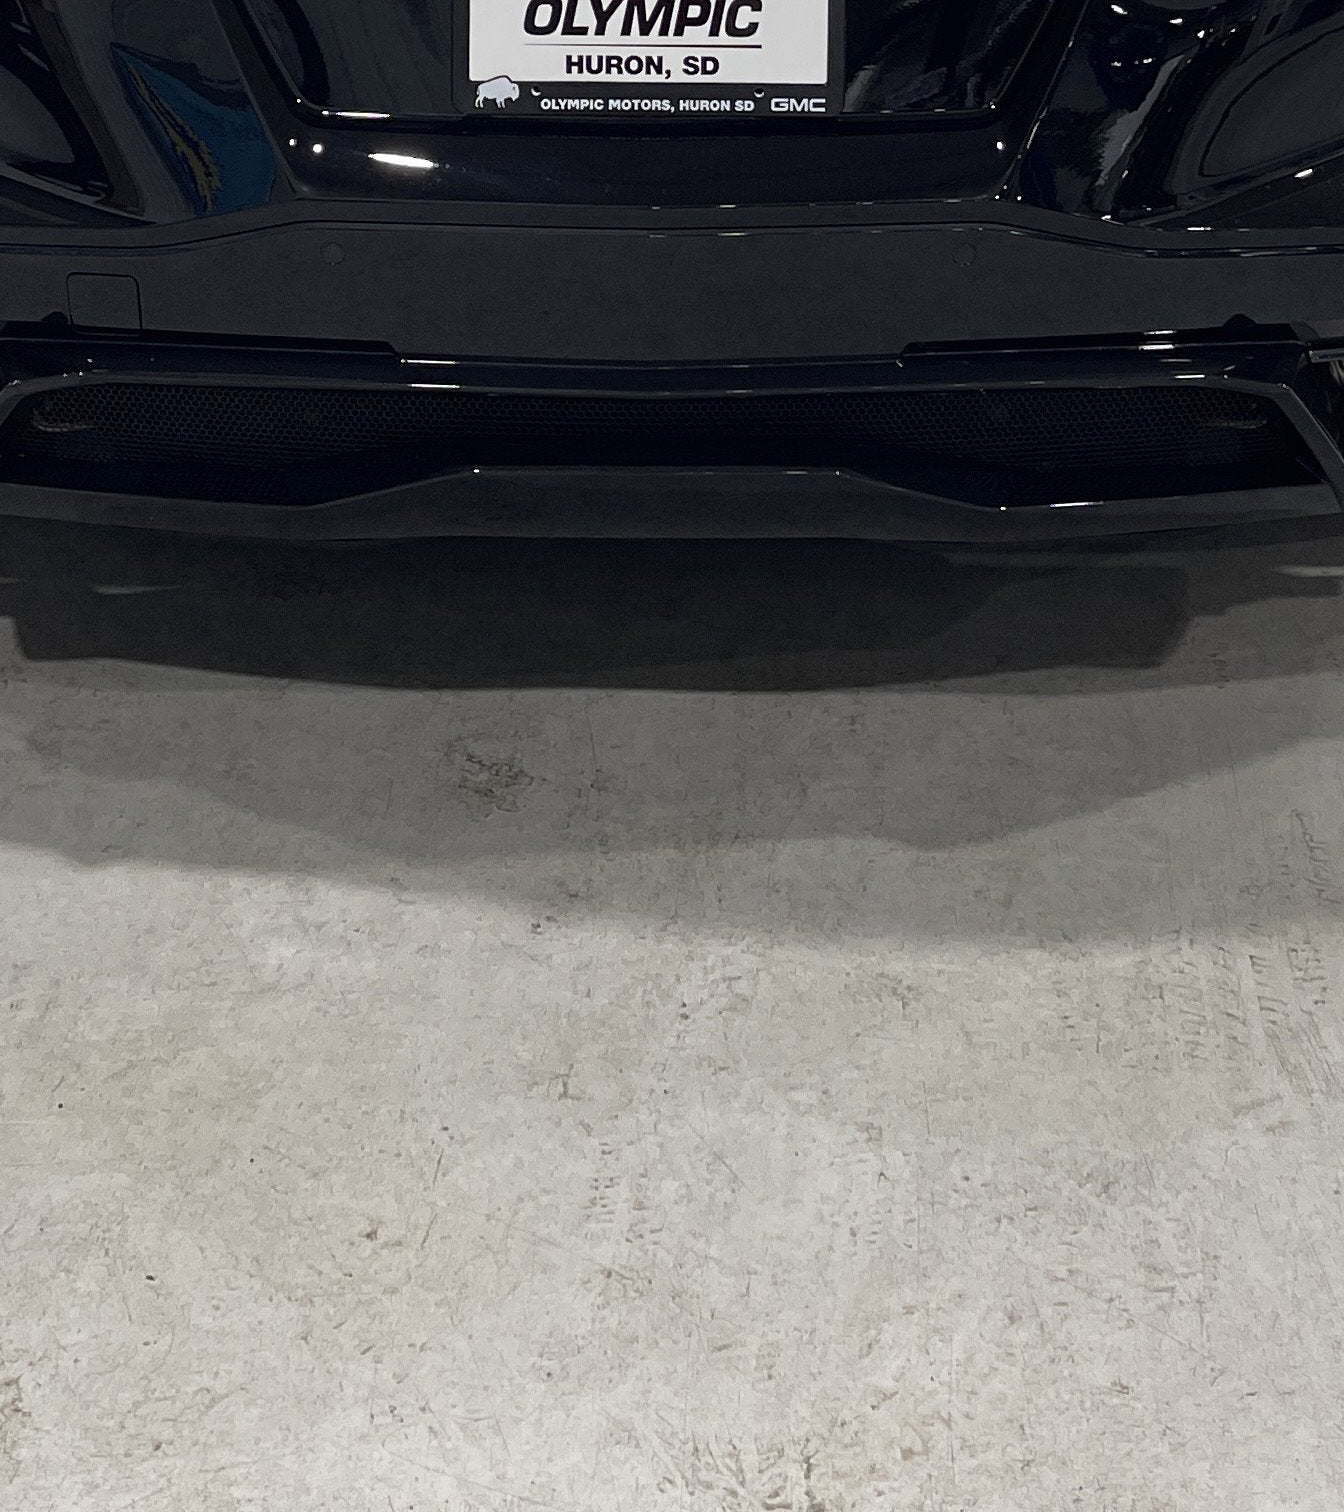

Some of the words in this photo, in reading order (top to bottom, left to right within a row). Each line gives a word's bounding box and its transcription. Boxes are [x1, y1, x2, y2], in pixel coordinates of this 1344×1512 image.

[565, 54, 673, 80] HURON,
[682, 55, 721, 76] SD
[539, 97, 605, 112] OLYMPIC
[608, 97, 676, 114] MOTORS,
[678, 98, 733, 113] HURON
[734, 98, 755, 113] SD
[769, 97, 827, 113] GMC
